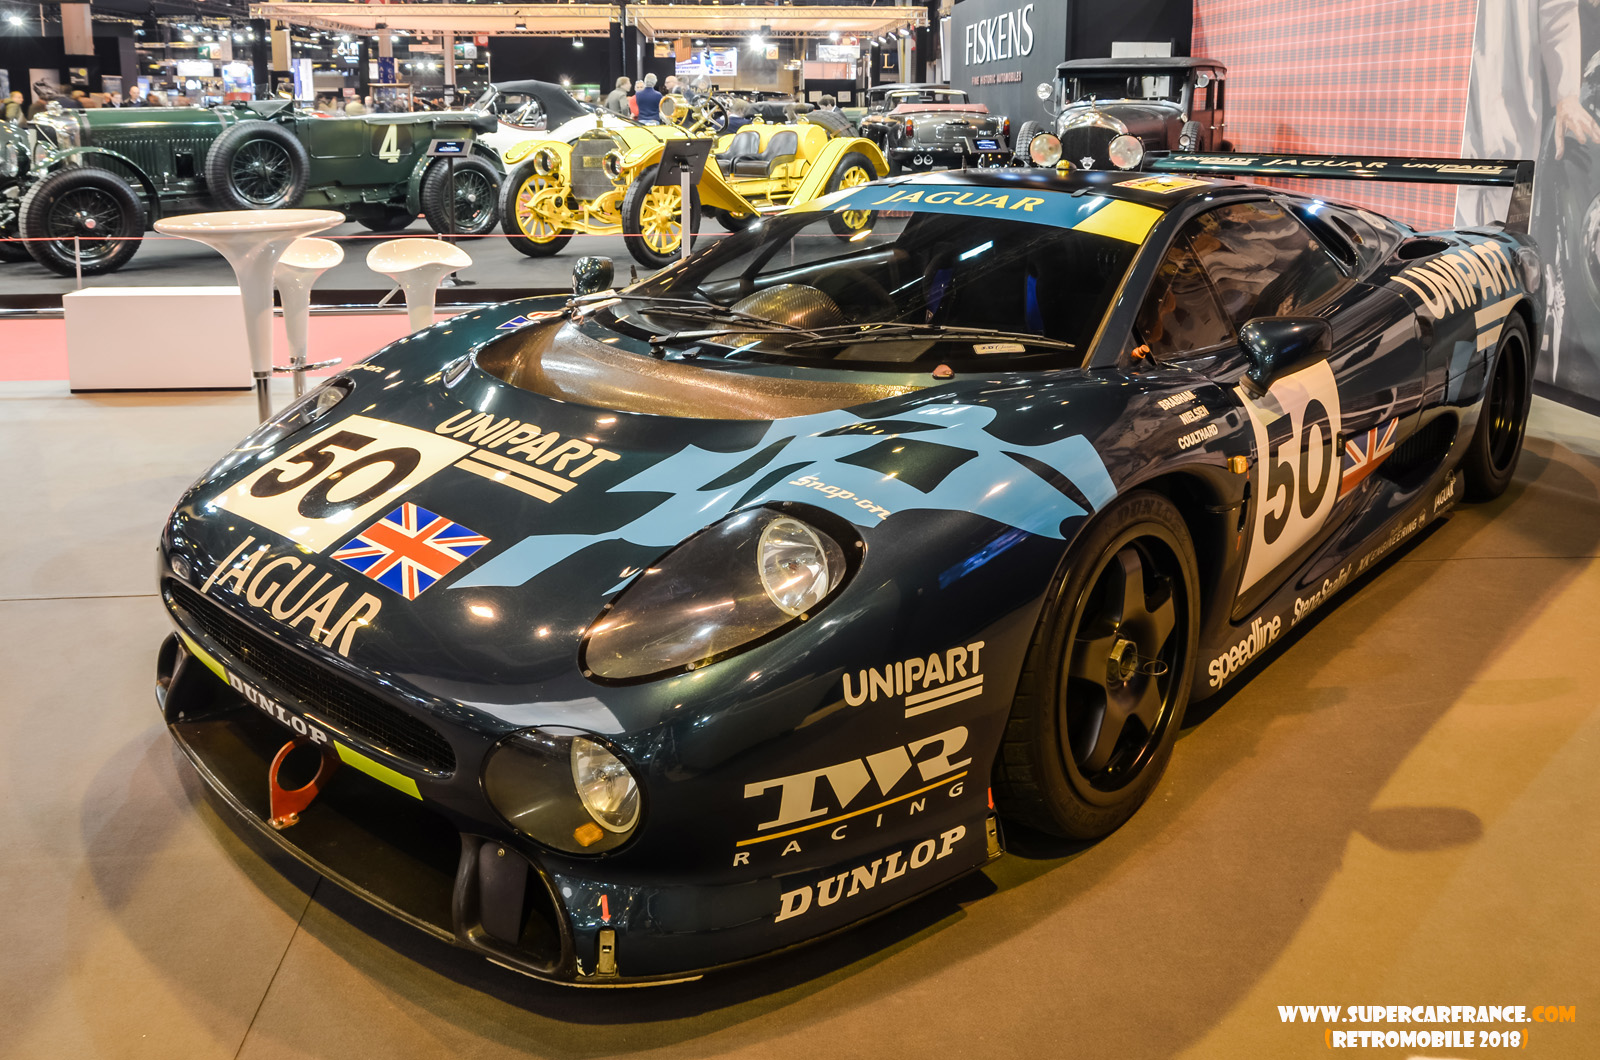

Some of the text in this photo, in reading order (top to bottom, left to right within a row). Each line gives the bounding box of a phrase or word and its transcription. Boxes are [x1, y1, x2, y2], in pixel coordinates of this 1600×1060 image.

[965, 3, 1034, 66] FISKENS
[379, 124, 401, 163] 4
[1262, 158, 1388, 169] JAGUAR
[1402, 162, 1509, 171] UNIPART
[871, 189, 1045, 212] JAGUAR
[1390, 240, 1517, 320] UNIPART
[1157, 390, 1197, 411] BRABHAM
[1179, 404, 1210, 426] NIELSEN
[435, 409, 621, 479] UNIPART
[1178, 423, 1219, 450] COULTHARD
[250, 430, 421, 520] 50
[788, 474, 892, 520] Snap-on
[1263, 397, 1332, 546] 50
[1433, 480, 1456, 513] JAGUAR
[201, 535, 383, 658] JAGUAR
[842, 640, 985, 706] UNIPART
[1208, 614, 1282, 690] speedline
[227, 672, 329, 747] DUNLOP
[743, 725, 973, 831] TWR
[733, 782, 965, 868] RACING
[775, 824, 967, 923] DUNLOP
